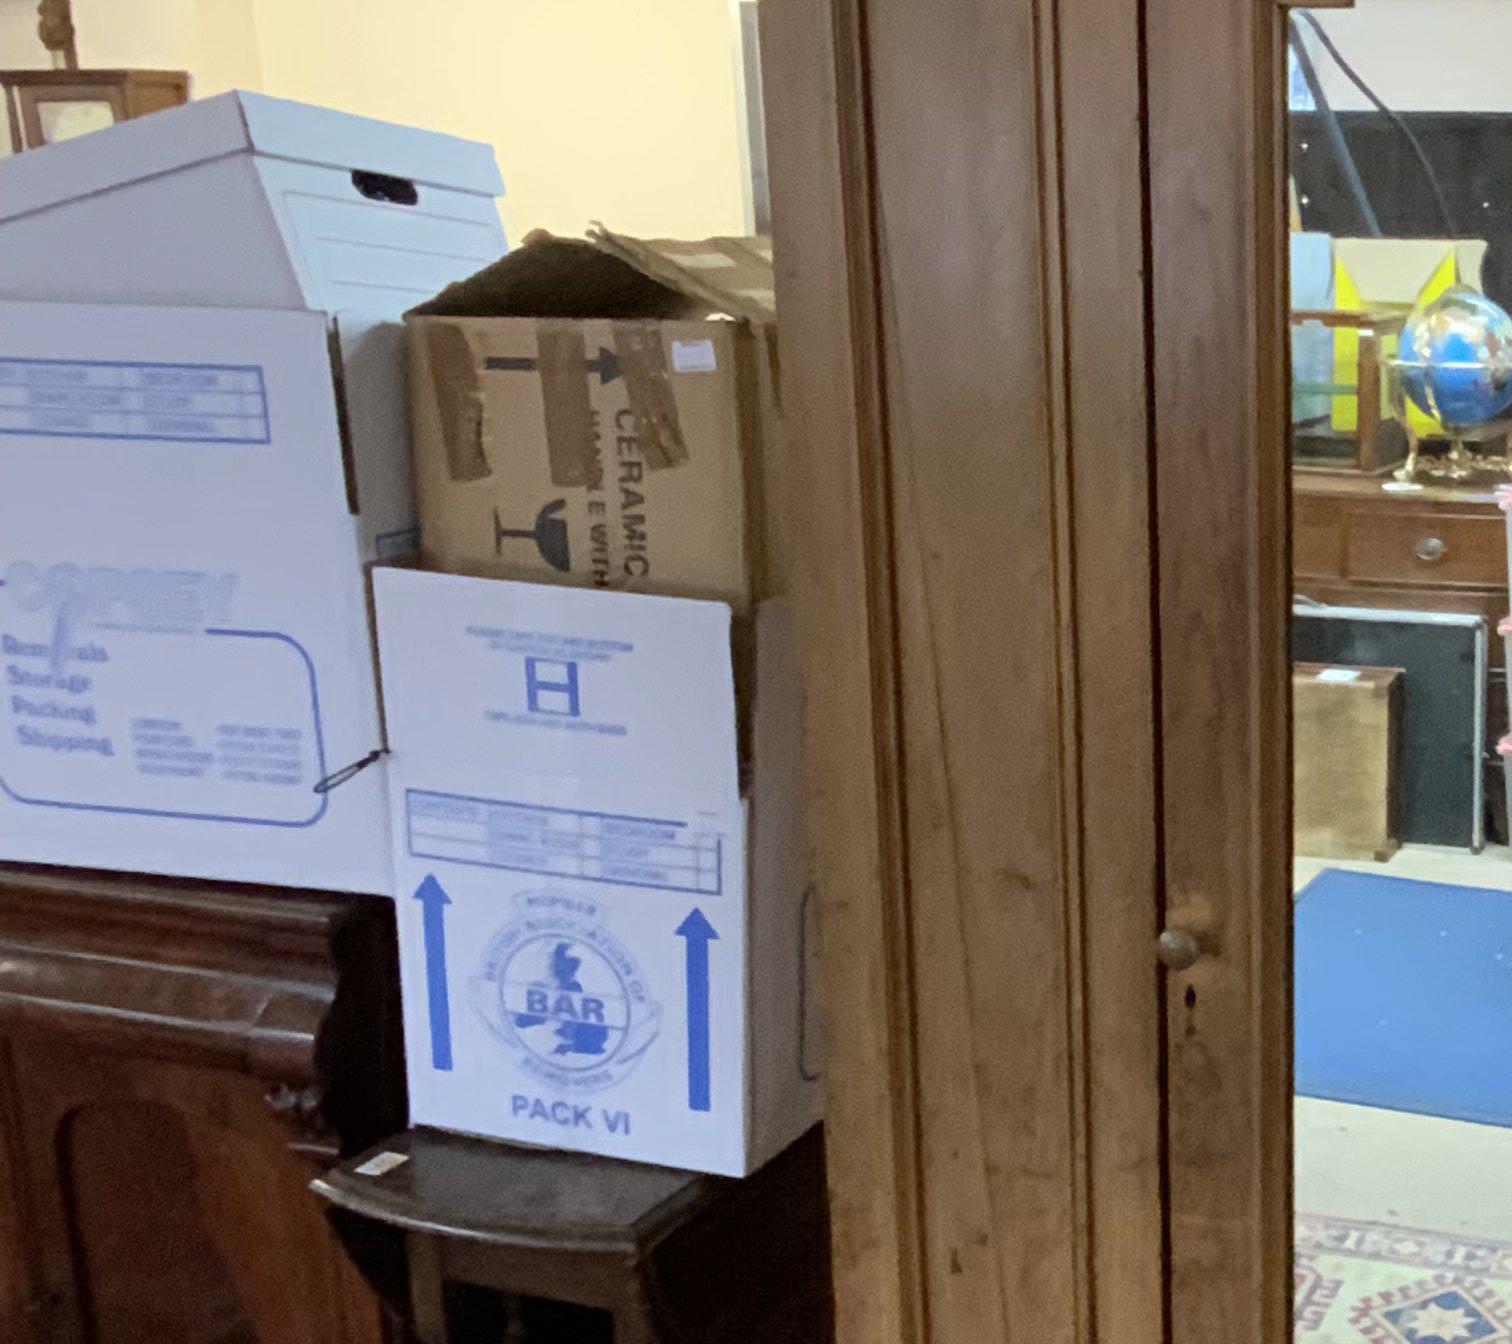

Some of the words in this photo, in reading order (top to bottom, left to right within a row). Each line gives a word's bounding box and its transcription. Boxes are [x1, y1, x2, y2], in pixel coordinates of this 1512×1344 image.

[615, 409, 649, 577] CERAMIC
[526, 988, 605, 1023] BAR
[511, 1094, 593, 1130] PACK
[602, 1109, 631, 1136] VI
